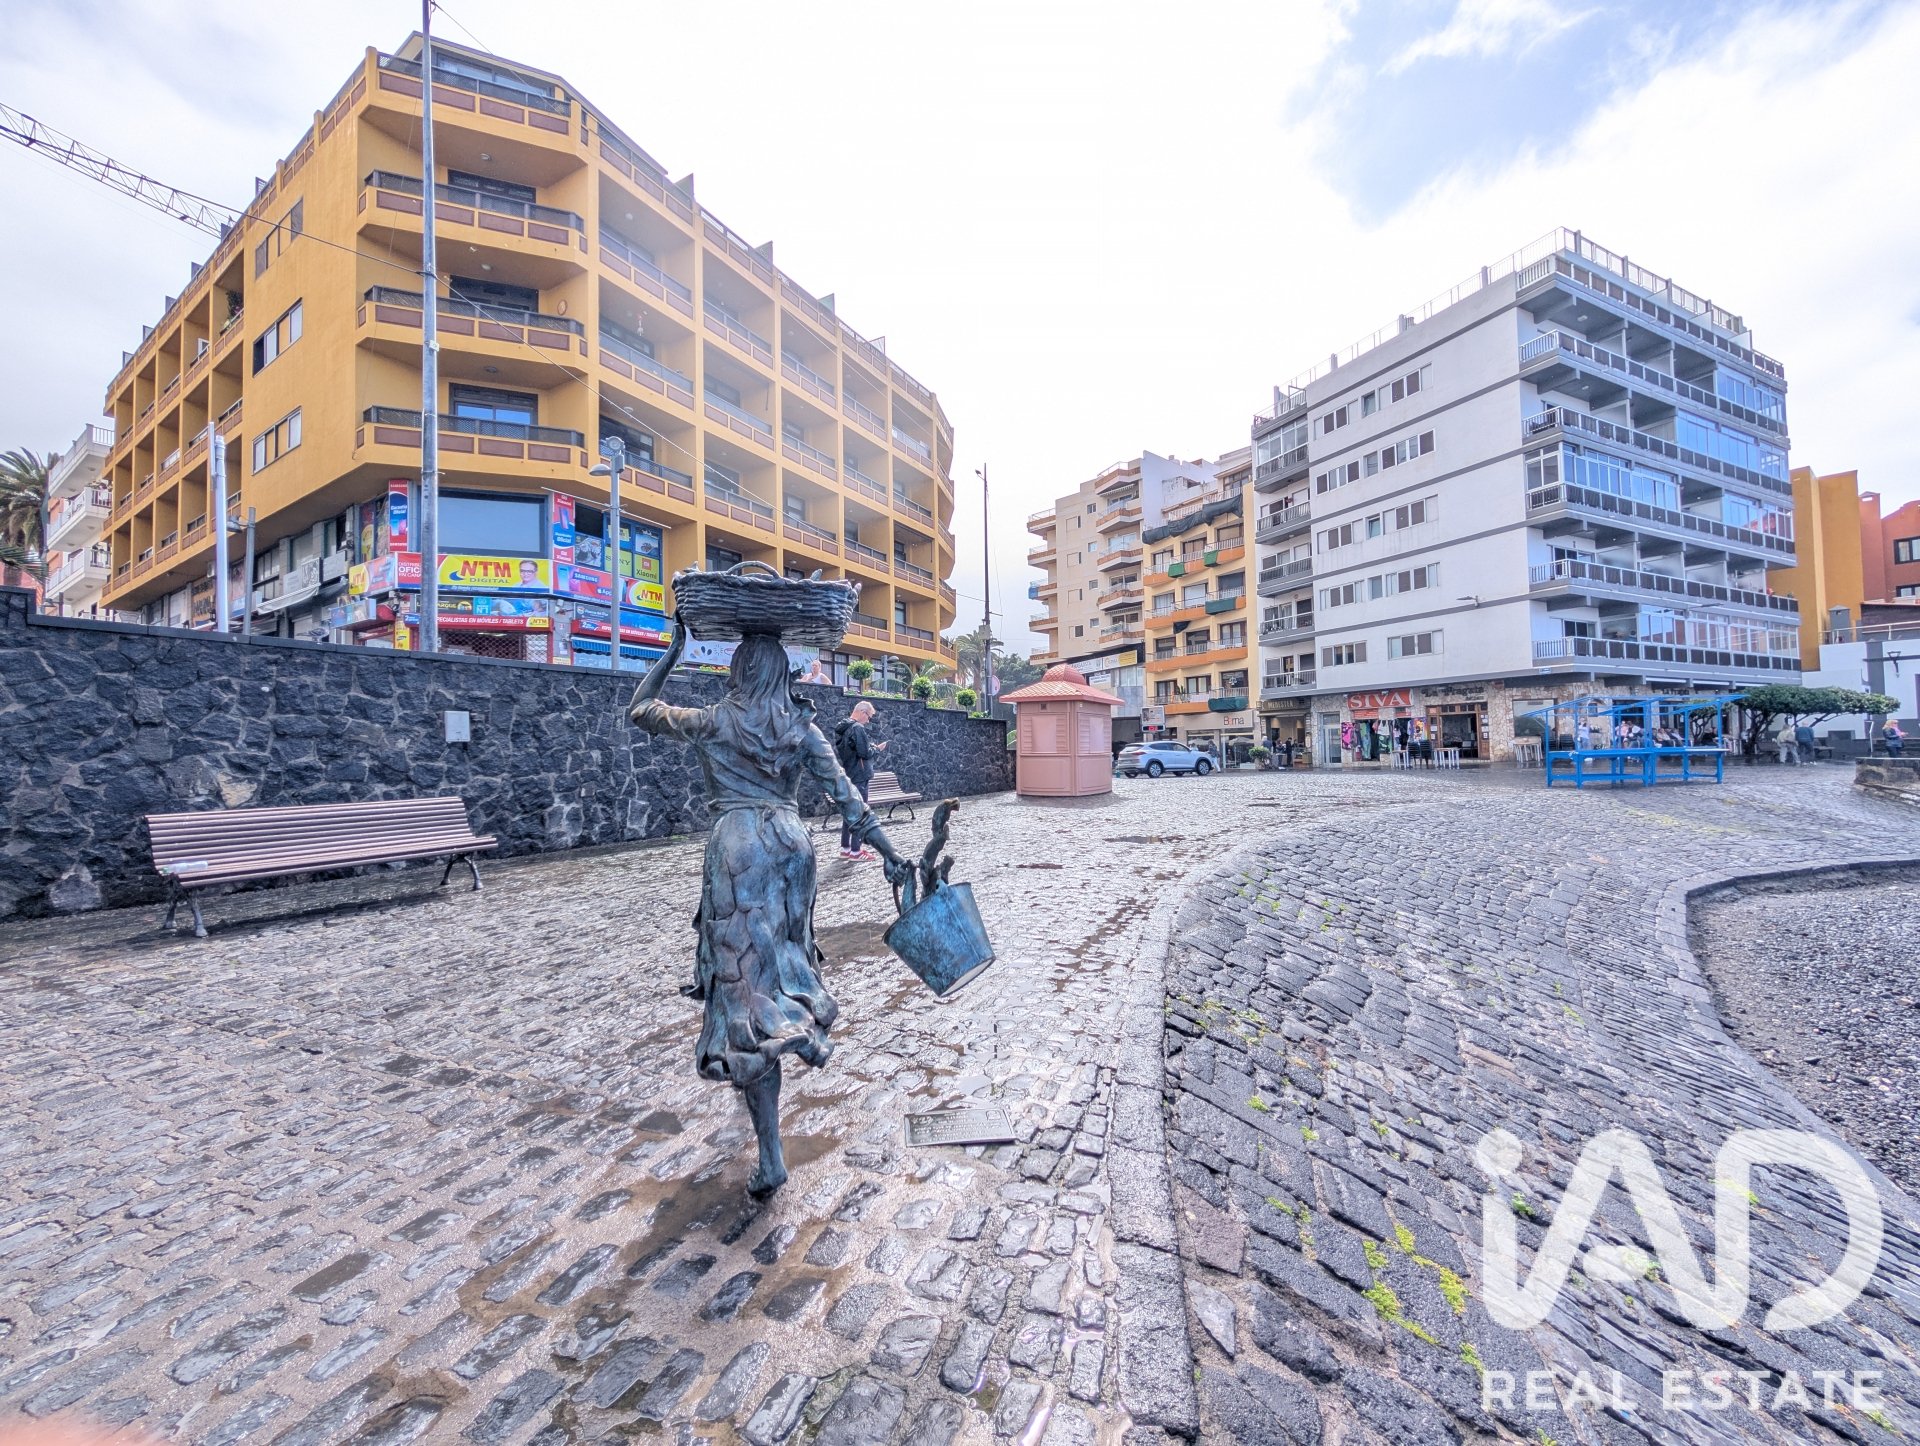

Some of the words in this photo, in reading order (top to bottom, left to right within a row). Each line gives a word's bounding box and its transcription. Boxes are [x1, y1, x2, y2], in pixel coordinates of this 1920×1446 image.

[605, 555, 631, 566] SNY
[460, 560, 512, 578] NTM
[636, 569, 657, 579] Xiaomi
[574, 572, 599, 583] SAMSUNG
[641, 590, 663, 602] NTM
[1351, 691, 1404, 708] SIVA
